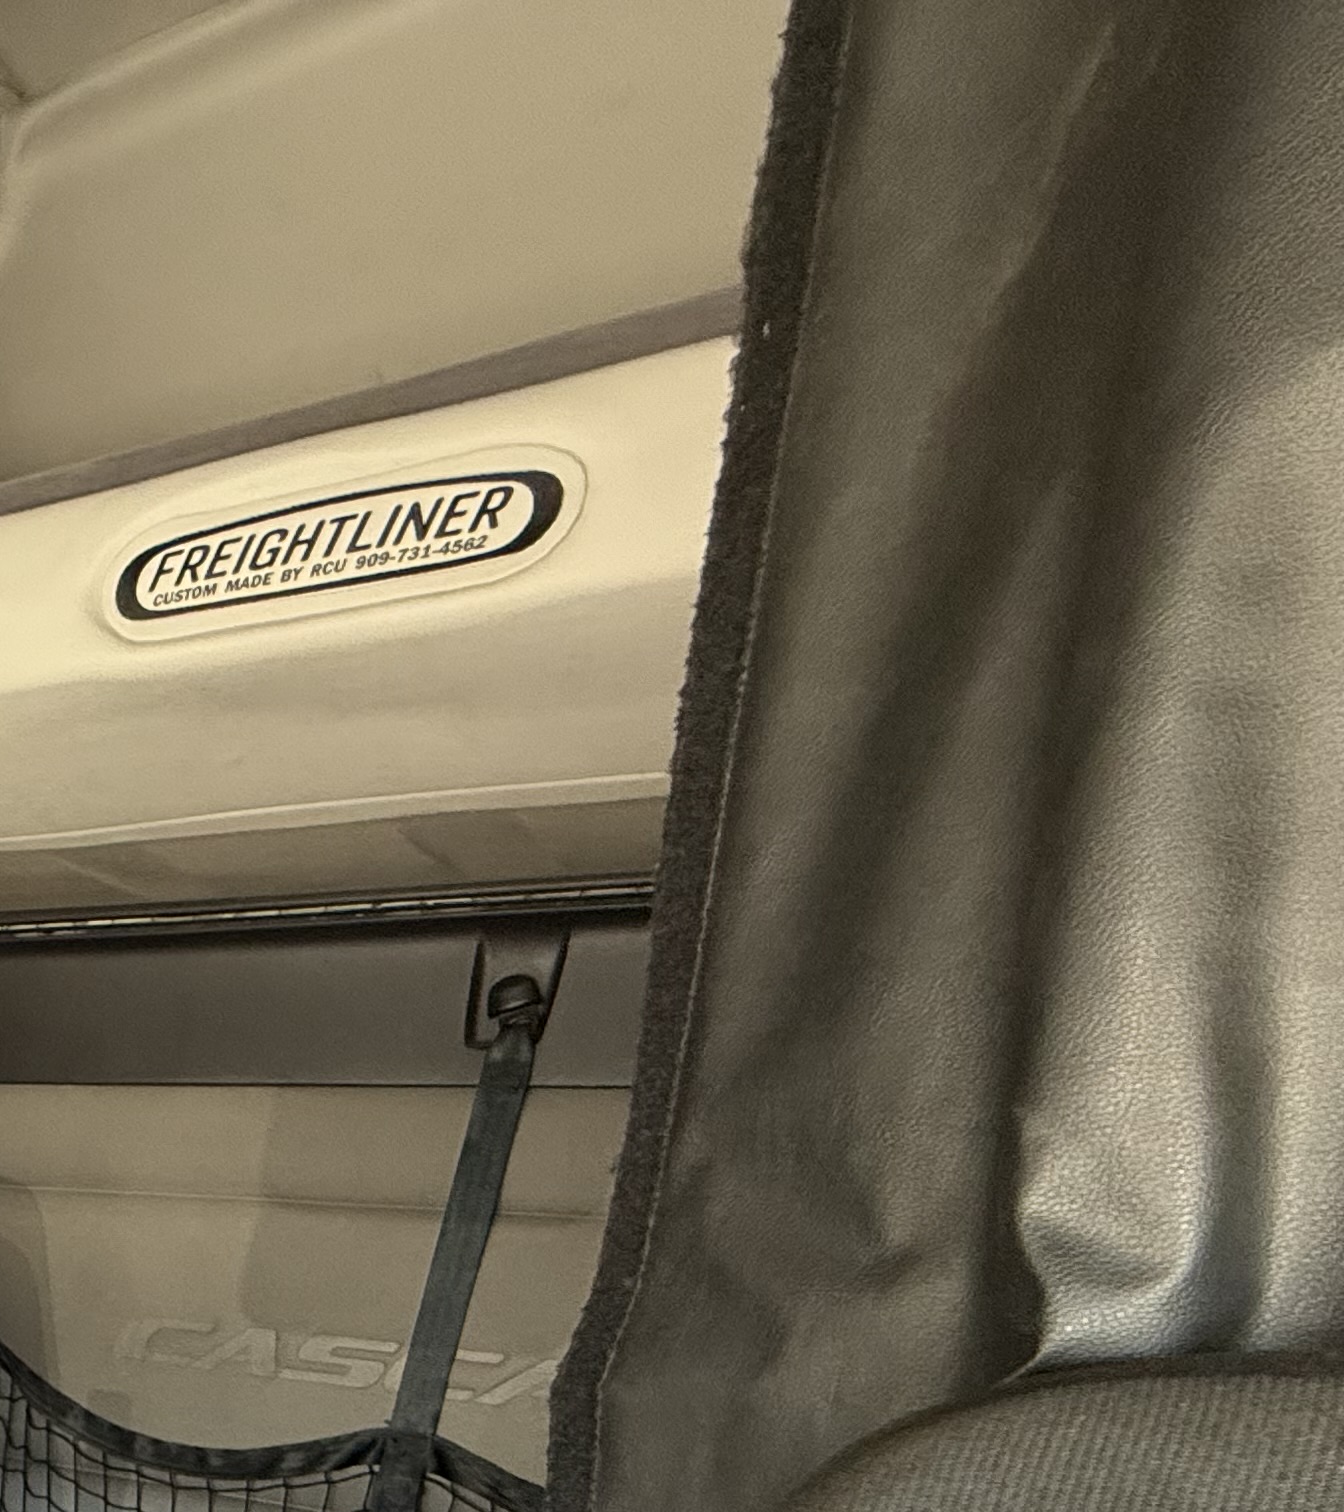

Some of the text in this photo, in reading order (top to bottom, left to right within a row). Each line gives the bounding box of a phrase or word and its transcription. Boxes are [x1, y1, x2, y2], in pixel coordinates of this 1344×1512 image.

[148, 486, 514, 593] FREIGHTLINER
[152, 534, 489, 607] CUSTOM MADE BY RCU 909-731-4562
